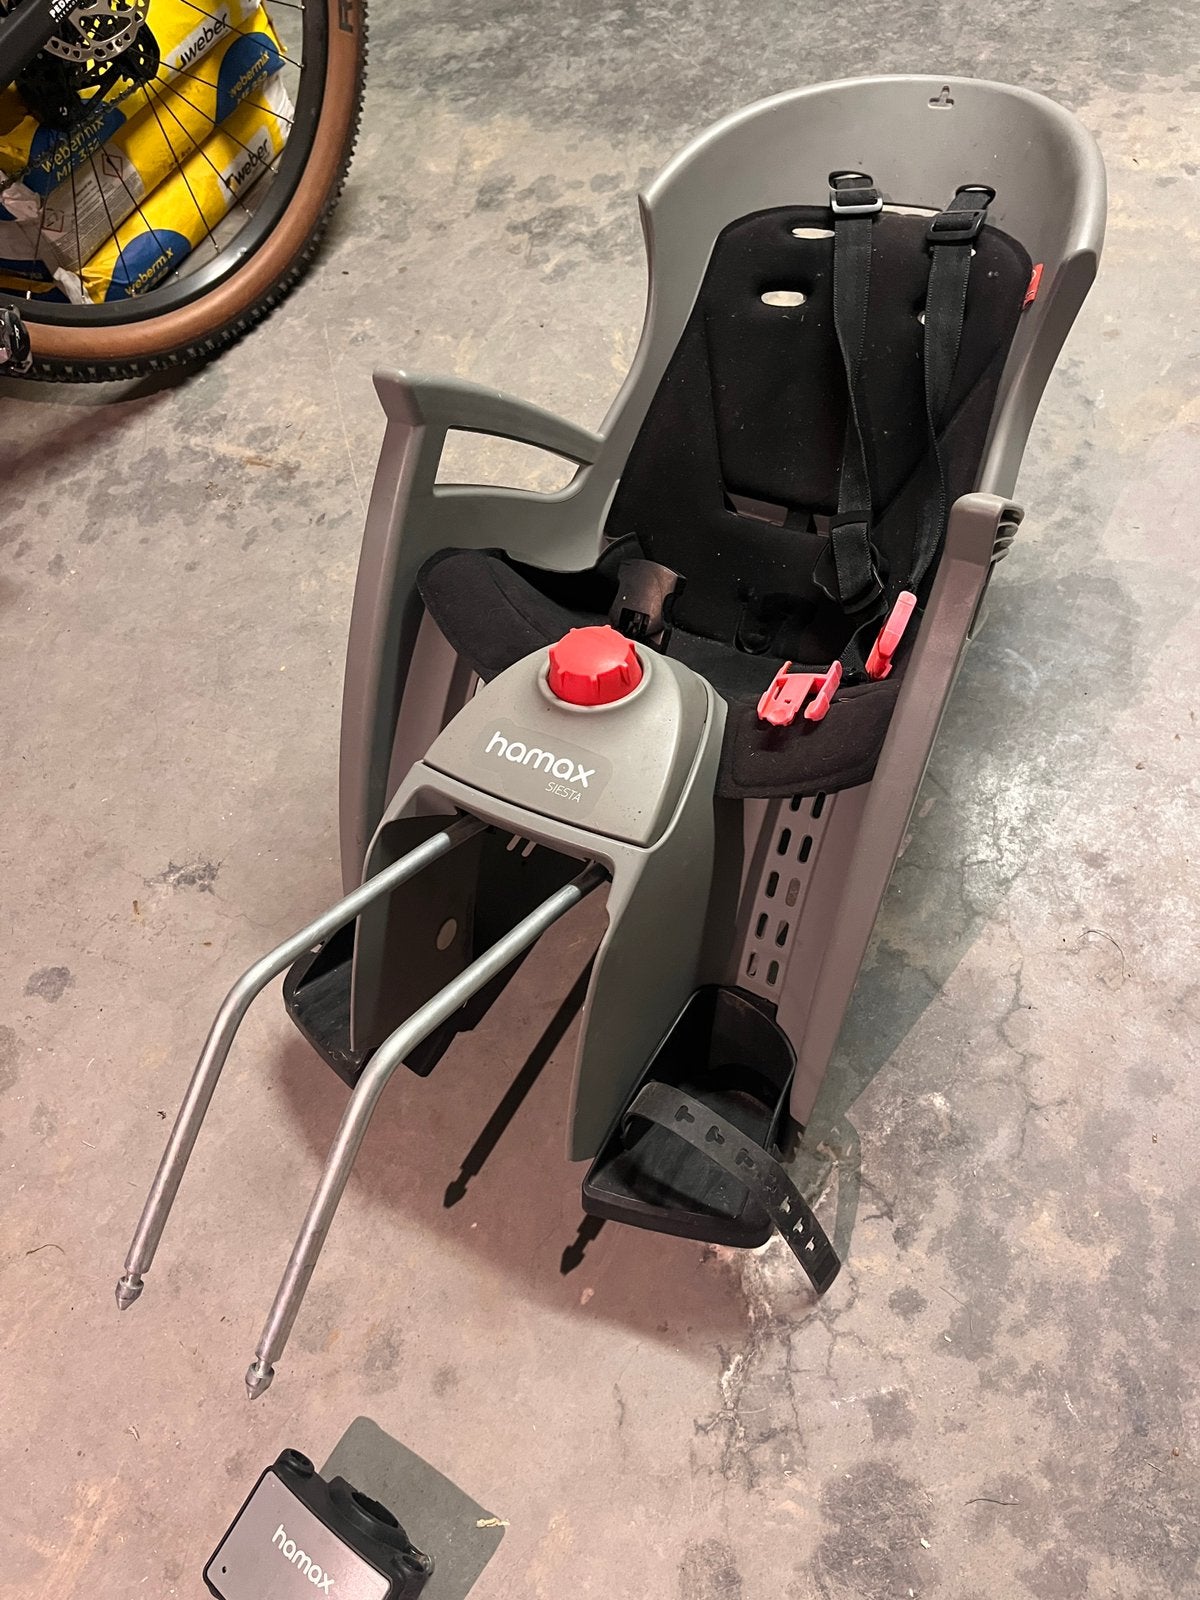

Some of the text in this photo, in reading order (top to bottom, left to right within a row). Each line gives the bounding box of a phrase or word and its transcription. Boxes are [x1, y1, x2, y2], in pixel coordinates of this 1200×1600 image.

[184, 13, 227, 62] weber
[234, 138, 268, 185] weber
[485, 731, 595, 788] hamax
[545, 781, 584, 803] SIESTA
[271, 1524, 335, 1595] hamax
